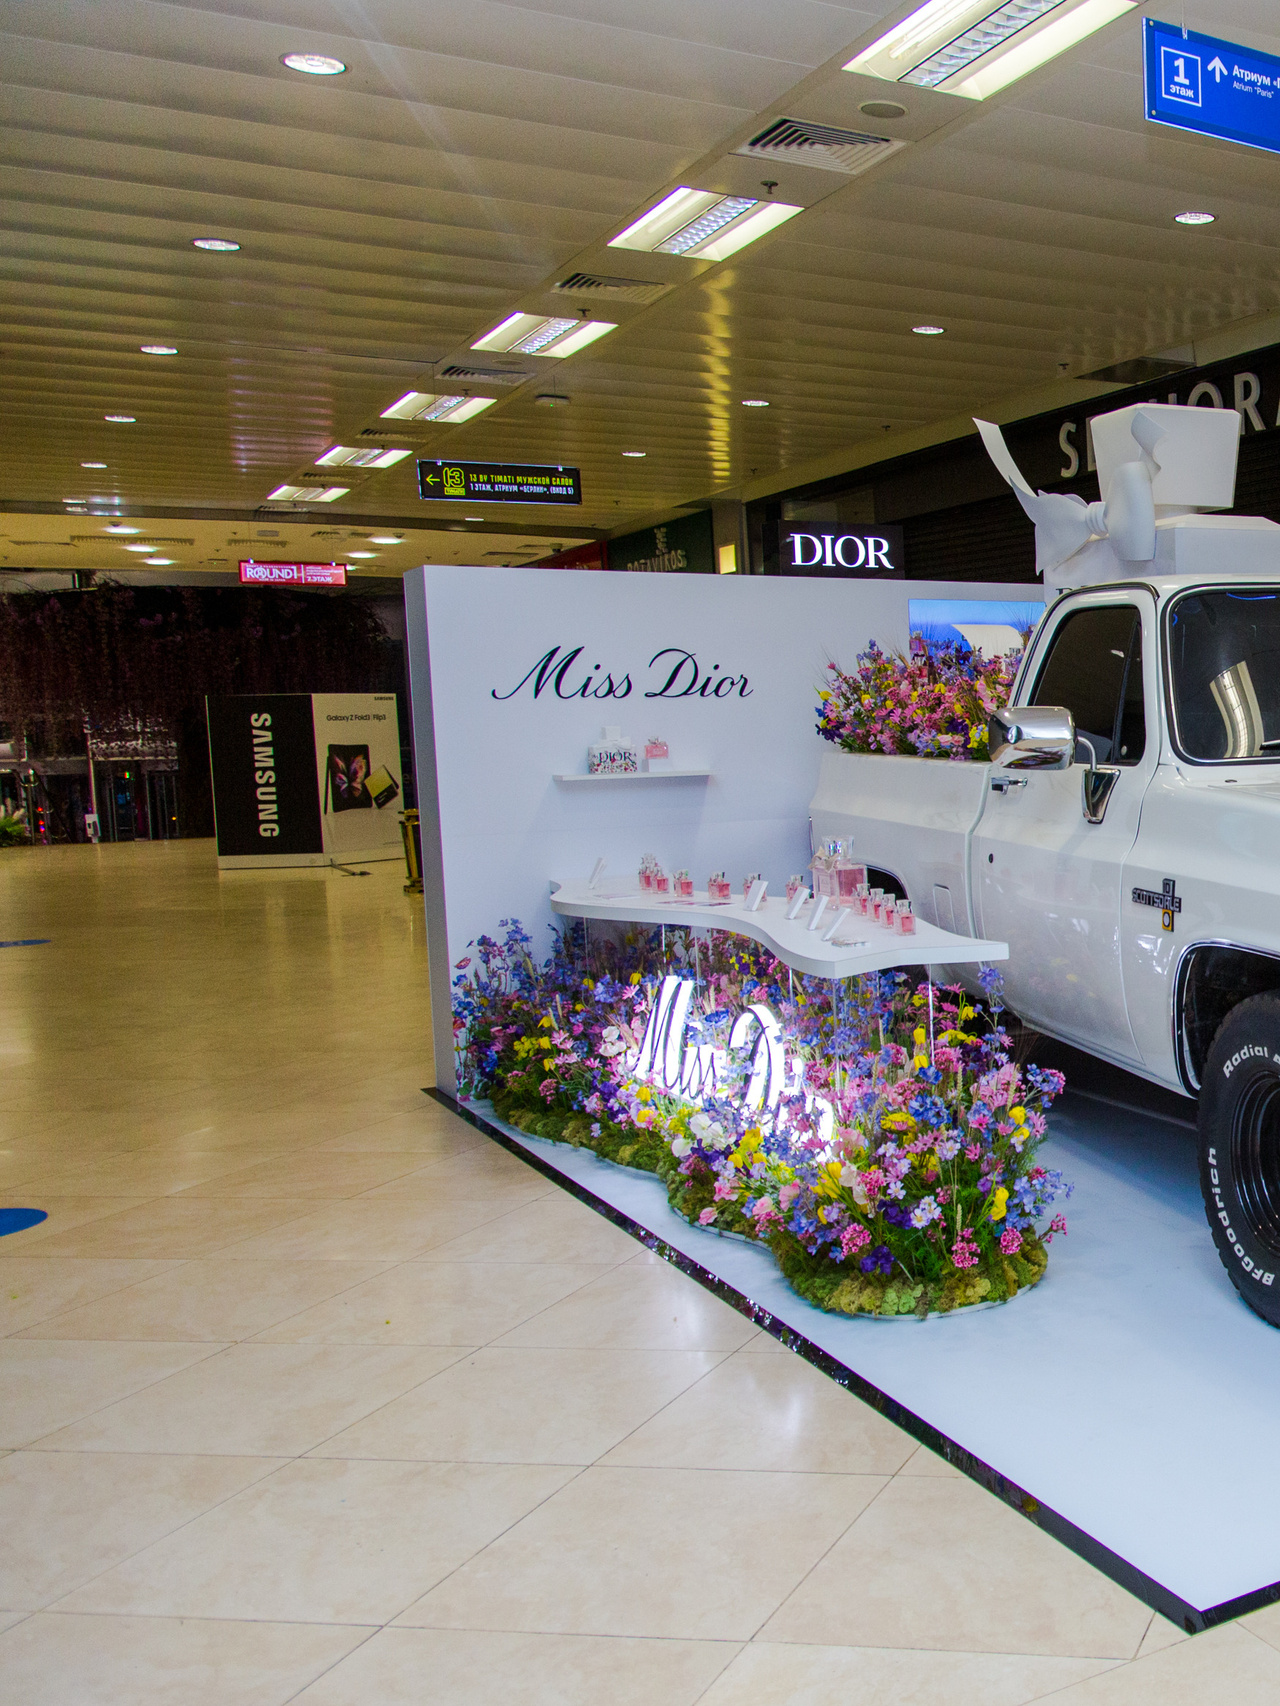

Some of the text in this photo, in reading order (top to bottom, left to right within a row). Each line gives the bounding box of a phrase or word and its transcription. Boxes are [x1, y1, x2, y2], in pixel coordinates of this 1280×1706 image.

[1174, 58, 1190, 85] 1
[1232, 65, 1271, 86] Атриум
[1169, 84, 1194, 99] этаж
[1233, 80, 1253, 94] Atrium
[469, 474, 478, 482] 13
[516, 476, 550, 485] МУЖСКОЙ
[552, 477, 573, 486] САЛОН
[494, 484, 518, 493] АТРИУМ
[789, 533, 895, 569] DIOR
[246, 566, 297, 580] ROUND1
[492, 645, 754, 700] Miss Dior
[326, 714, 349, 722] Galaxy
[373, 714, 386, 722] Flip3
[599, 751, 636, 764] DIOR
[250, 713, 280, 837] SAMSUNG
[1223, 1044, 1268, 1078] Radial
